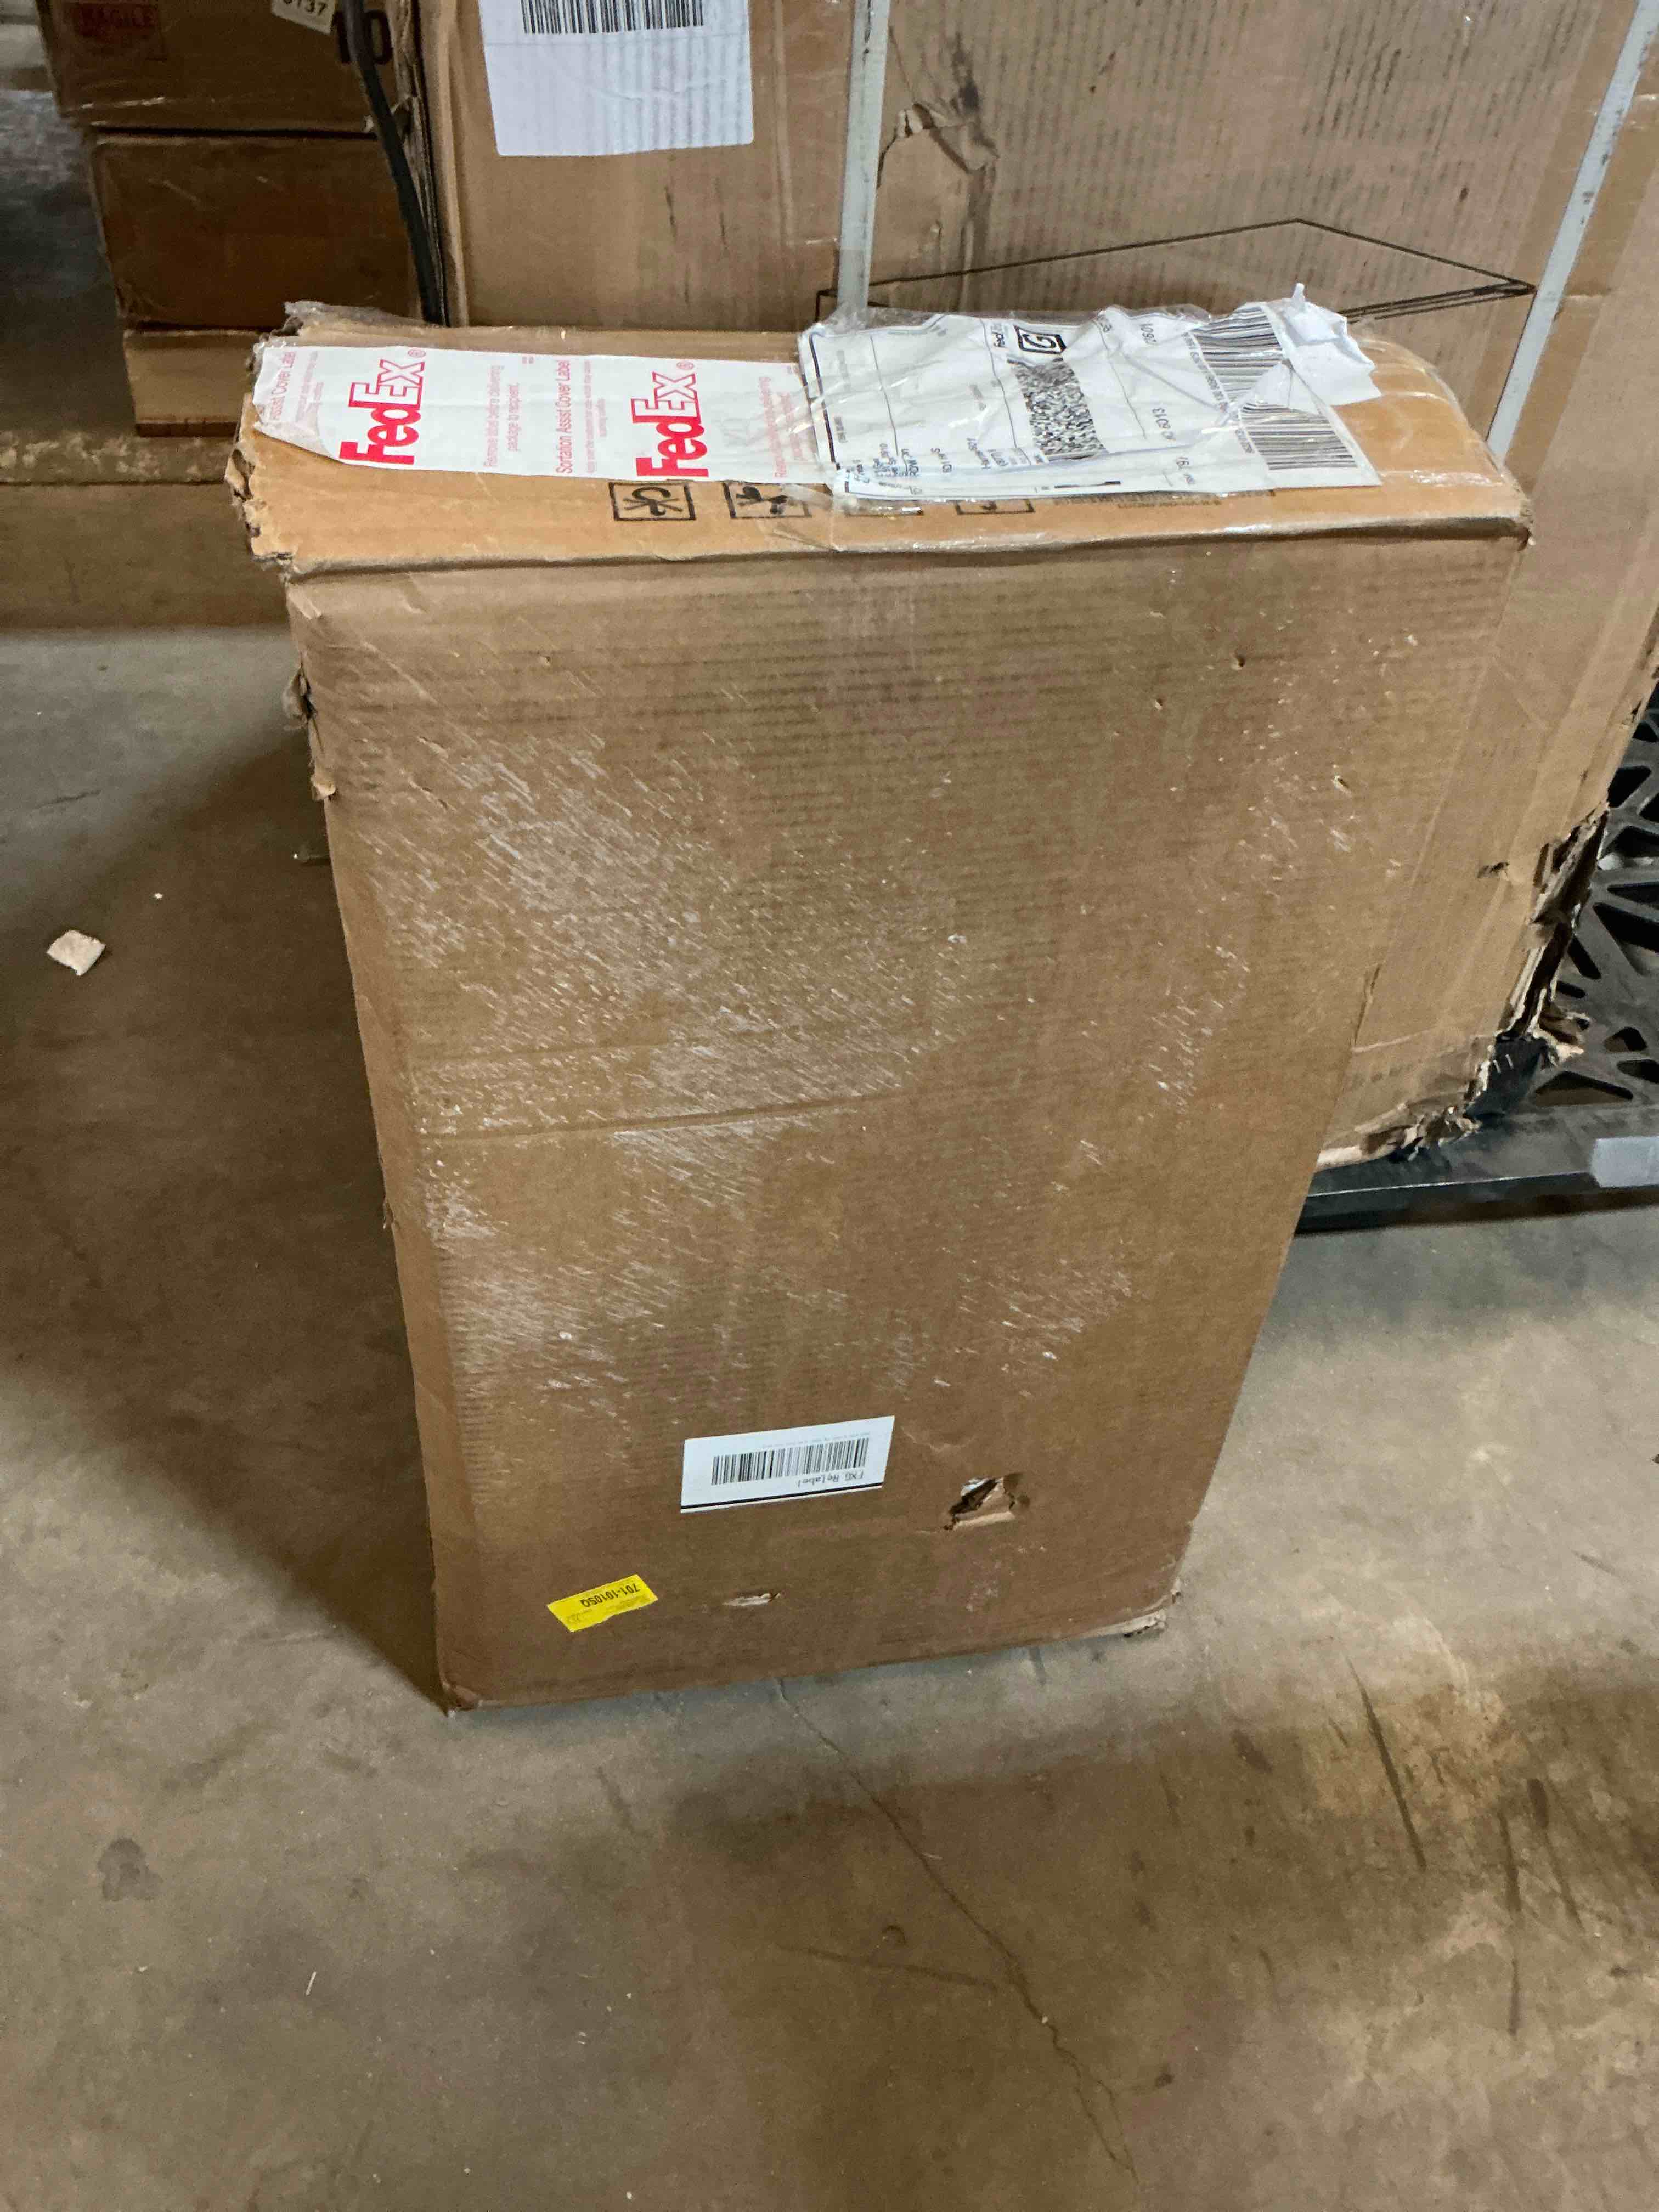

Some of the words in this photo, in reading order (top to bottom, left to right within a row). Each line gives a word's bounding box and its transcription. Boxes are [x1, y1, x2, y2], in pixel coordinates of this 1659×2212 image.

[282, 0, 328, 16] 137
[554, 359, 571, 381] Label
[554, 382, 572, 409] Cover
[339, 359, 426, 465] FedEx
[555, 410, 571, 432] Assist
[629, 371, 709, 477] FedEx
[555, 436, 573, 474] Sortation
[843, 1471, 864, 1483] FXG
